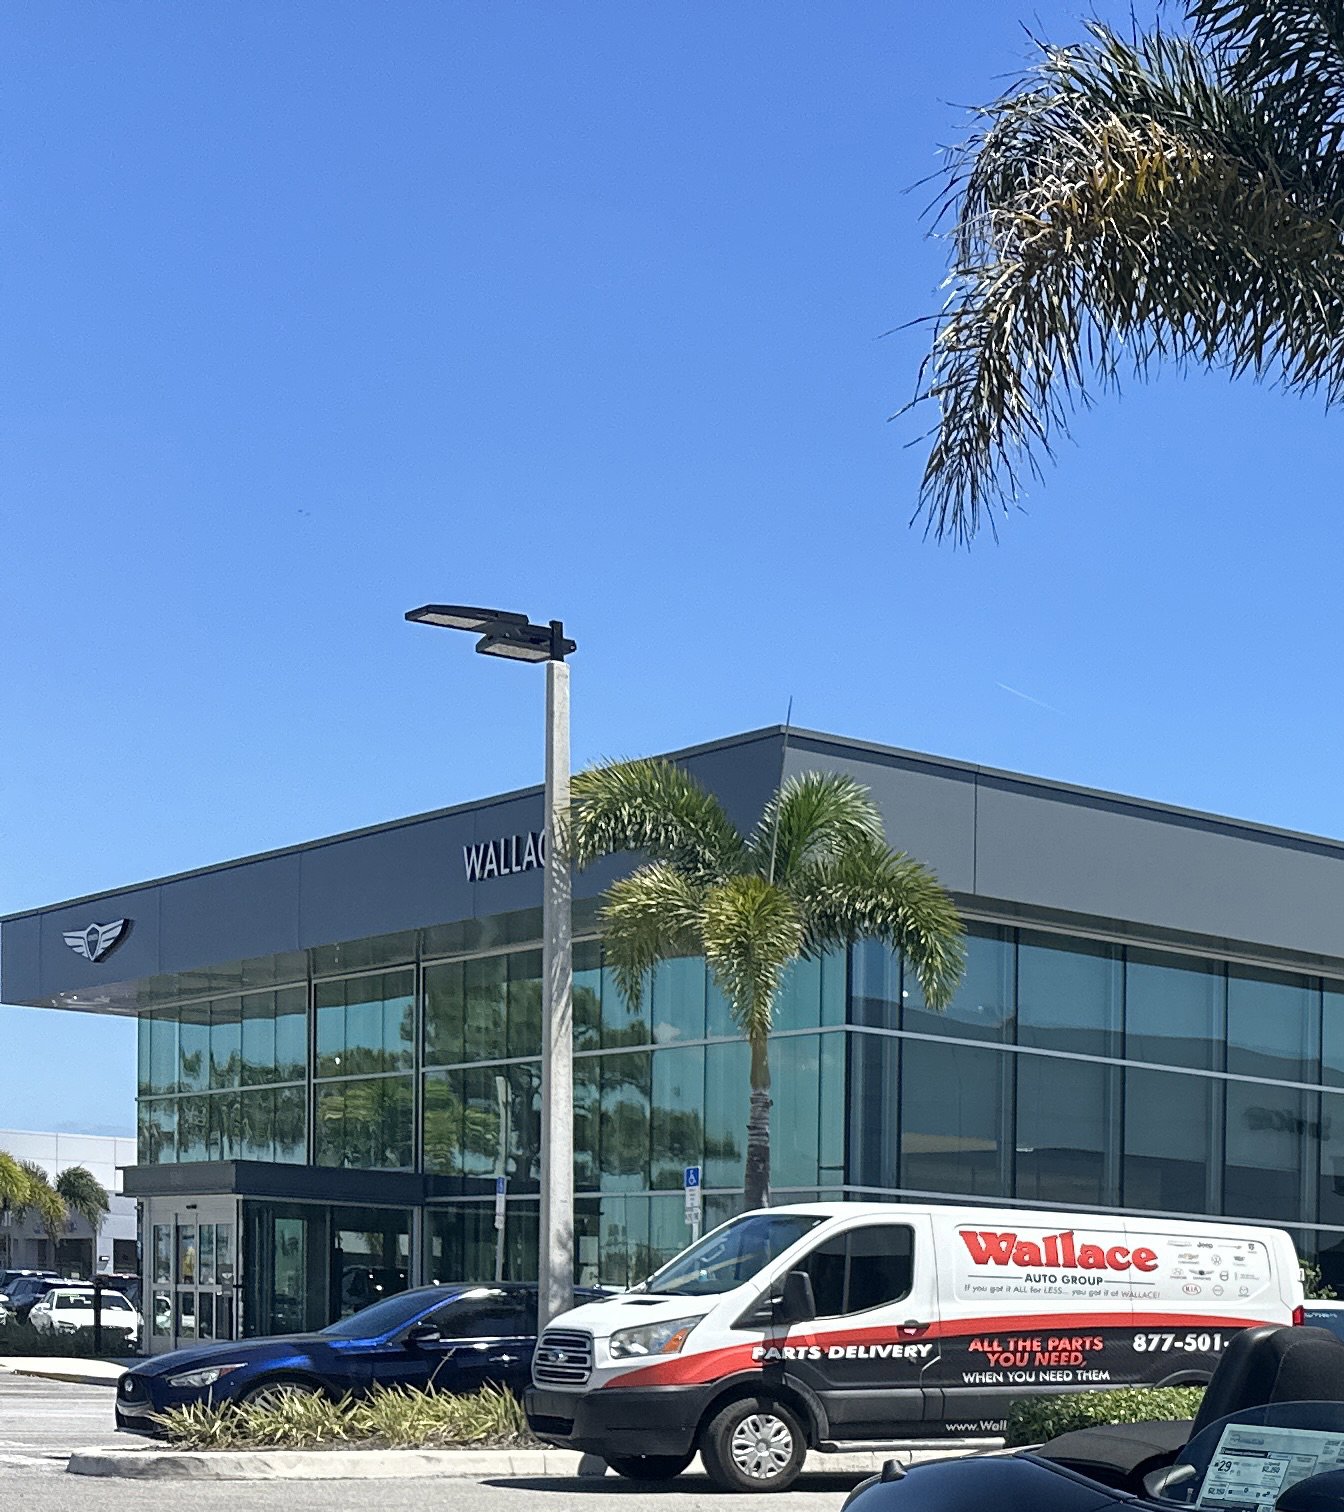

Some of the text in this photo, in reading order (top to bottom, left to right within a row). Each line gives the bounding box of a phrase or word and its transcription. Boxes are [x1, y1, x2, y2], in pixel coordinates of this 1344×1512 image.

[958, 1229, 1159, 1272] Wallace
[1024, 1273, 1103, 1286] AUTO GROUP
[1013, 1286, 1027, 1294] ALL
[968, 1336, 1104, 1351] ALL THE PARTS
[752, 1343, 933, 1360] PARTS DELIVERY
[987, 1352, 1087, 1367] YOU NEED,
[962, 1369, 1110, 1383] WHEN YOU NEED THEM
[1217, 1460, 1232, 1472] 29
